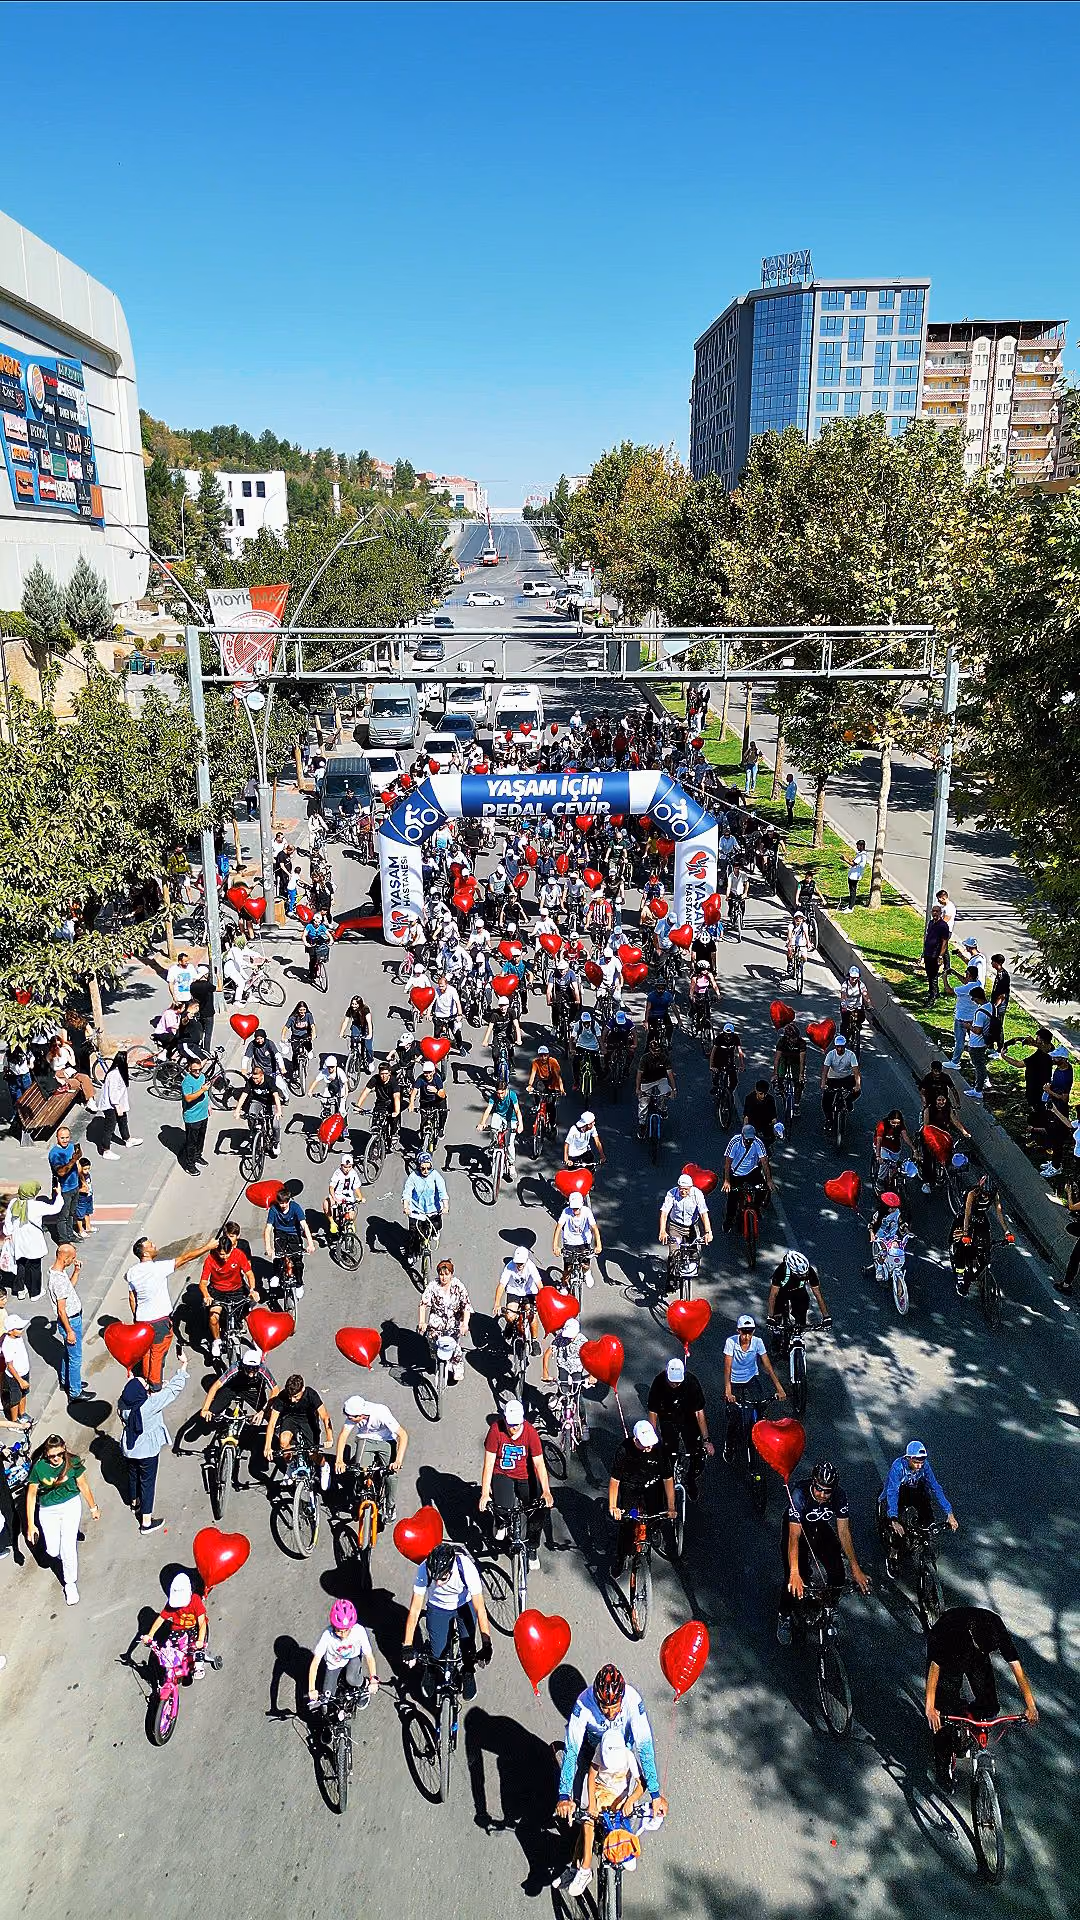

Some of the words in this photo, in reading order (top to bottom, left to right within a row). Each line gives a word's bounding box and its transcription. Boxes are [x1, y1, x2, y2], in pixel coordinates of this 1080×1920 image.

[487, 779, 557, 802] YAŞAM
[561, 775, 603, 801] İÇİN
[482, 803, 546, 816] PEDAL
[685, 883, 693, 925] HASTANE
[500, 1443, 526, 1469] F
